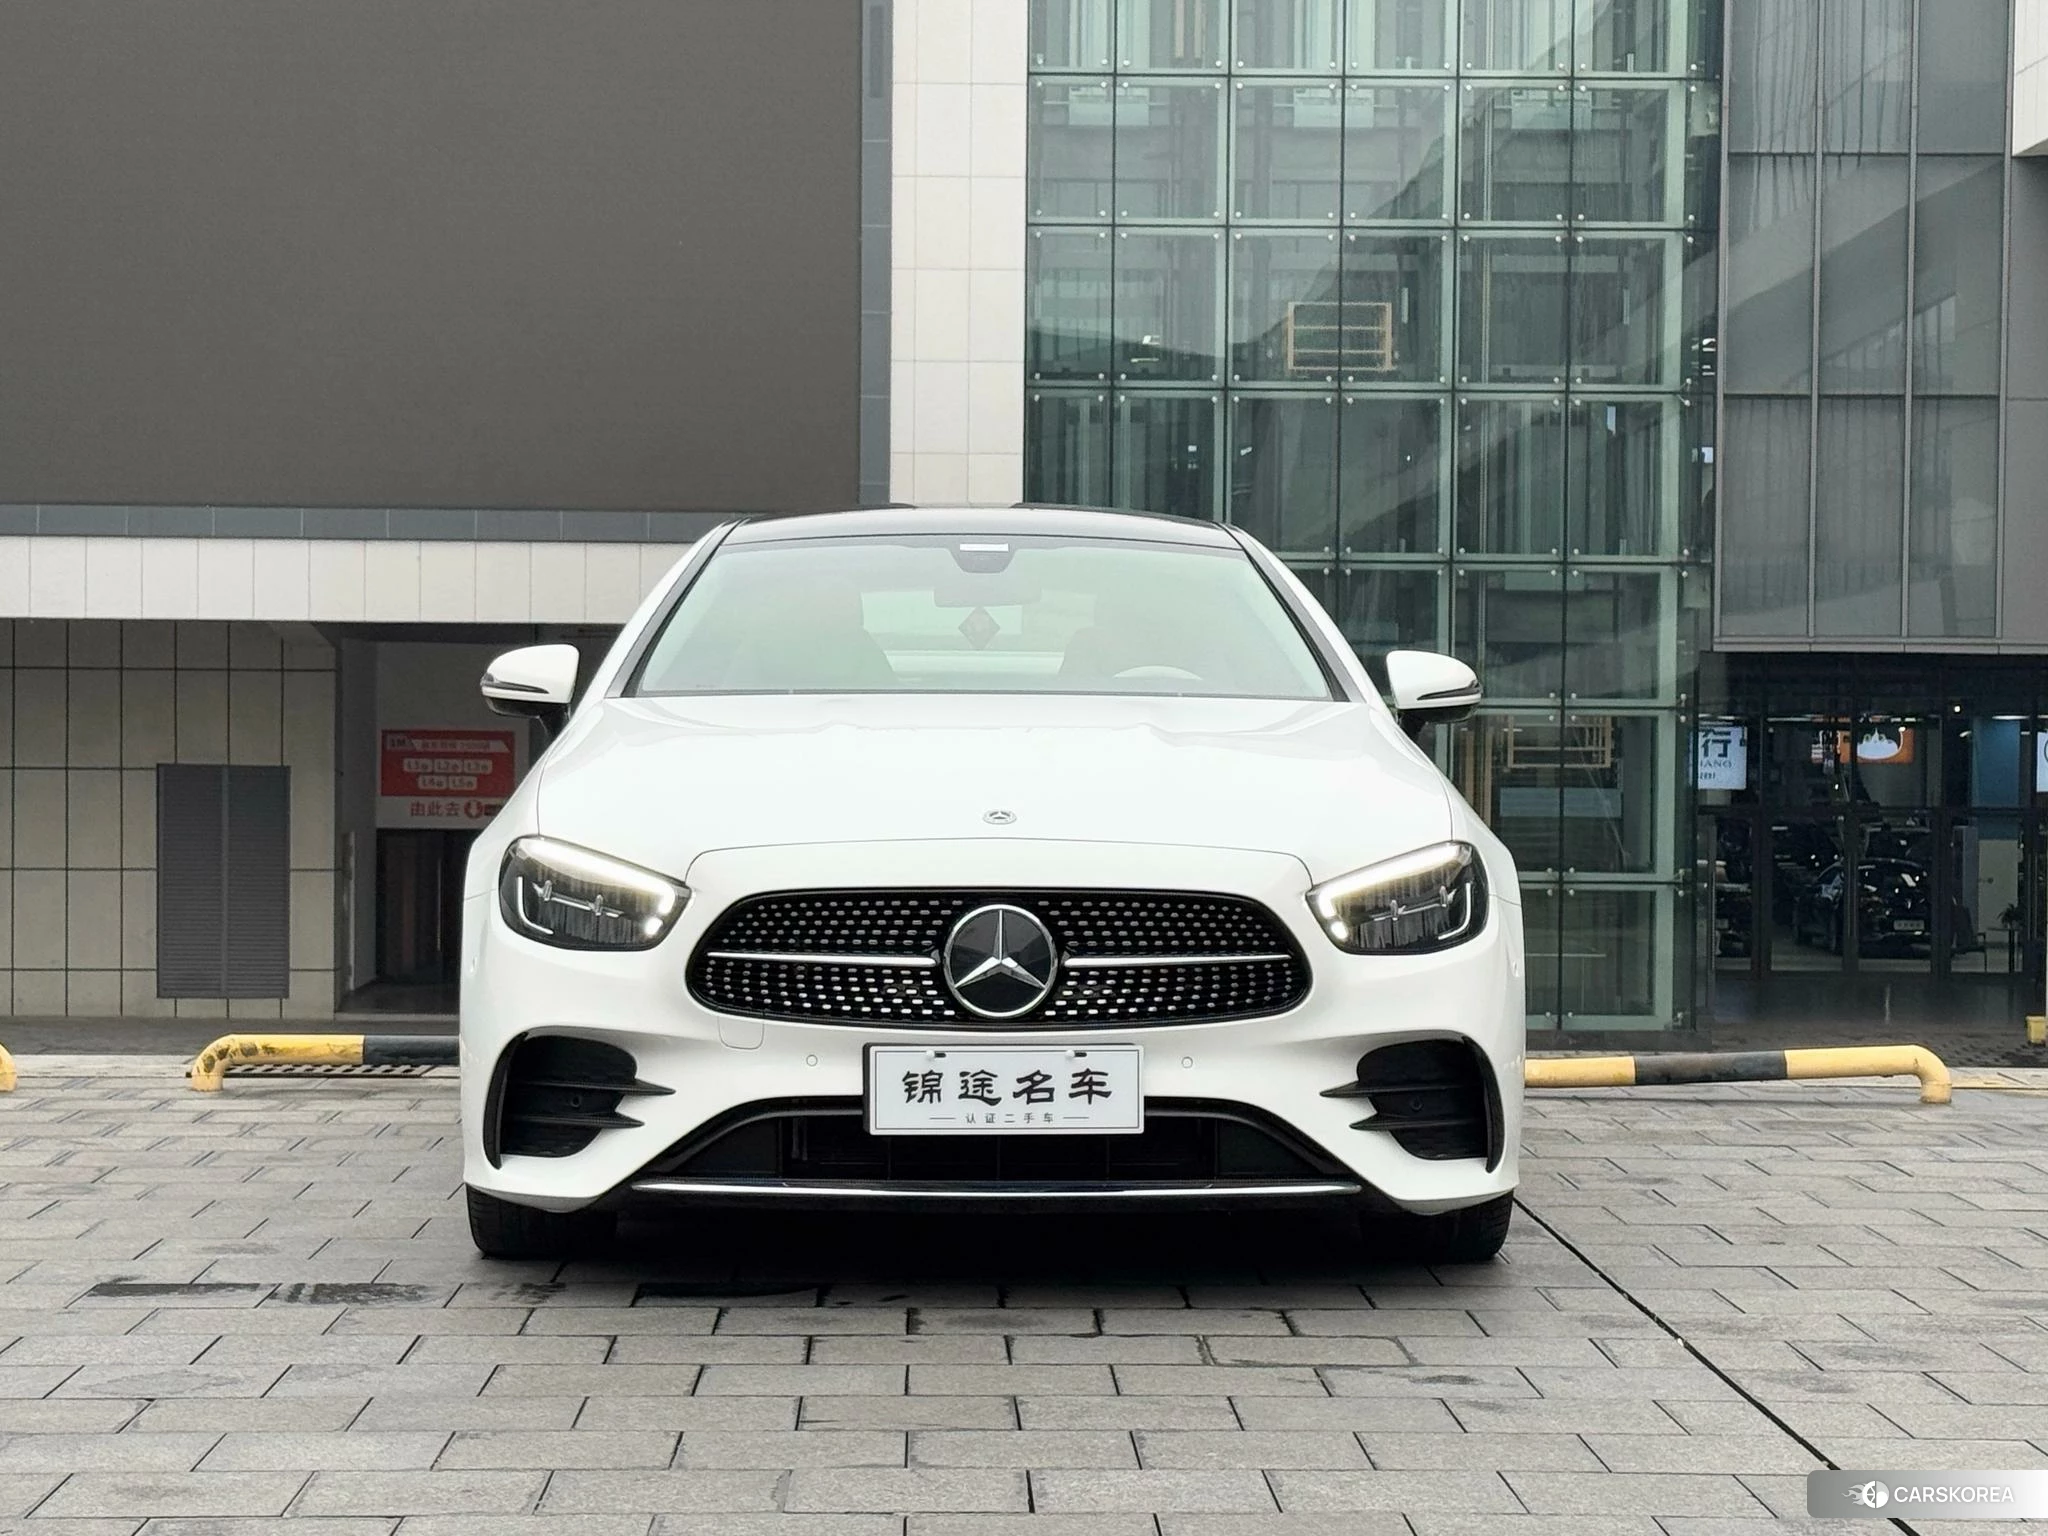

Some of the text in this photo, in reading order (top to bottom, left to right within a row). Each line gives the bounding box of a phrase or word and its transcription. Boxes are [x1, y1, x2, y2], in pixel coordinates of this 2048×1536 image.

[410, 799, 460, 818] 由此去
[901, 1067, 1113, 1106] 锦途名车
[965, 1112, 1055, 1124] 认证二手车
